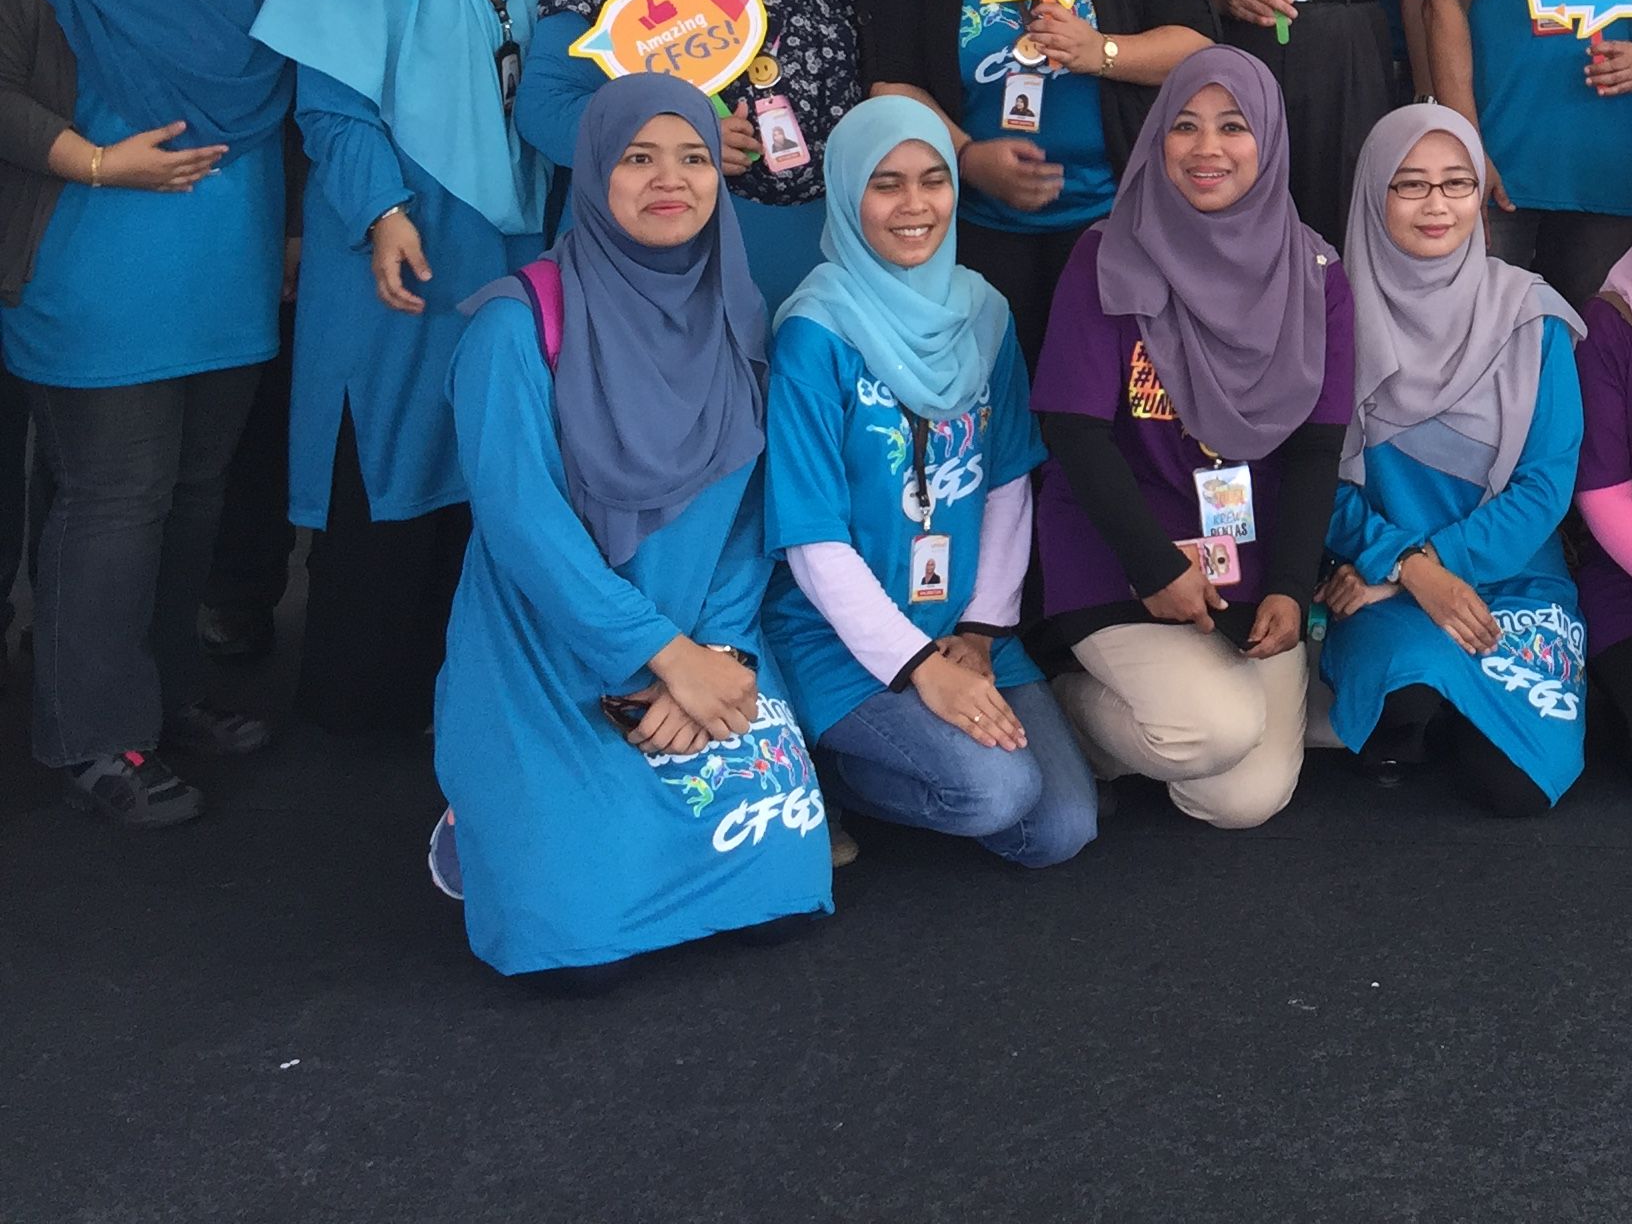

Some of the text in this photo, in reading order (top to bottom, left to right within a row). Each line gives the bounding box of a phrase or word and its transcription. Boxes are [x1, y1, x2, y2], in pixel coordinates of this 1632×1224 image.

[635, 12, 709, 56] Amazing
[1481, 656, 1580, 721] CFGS
[712, 786, 825, 853] CFGS
